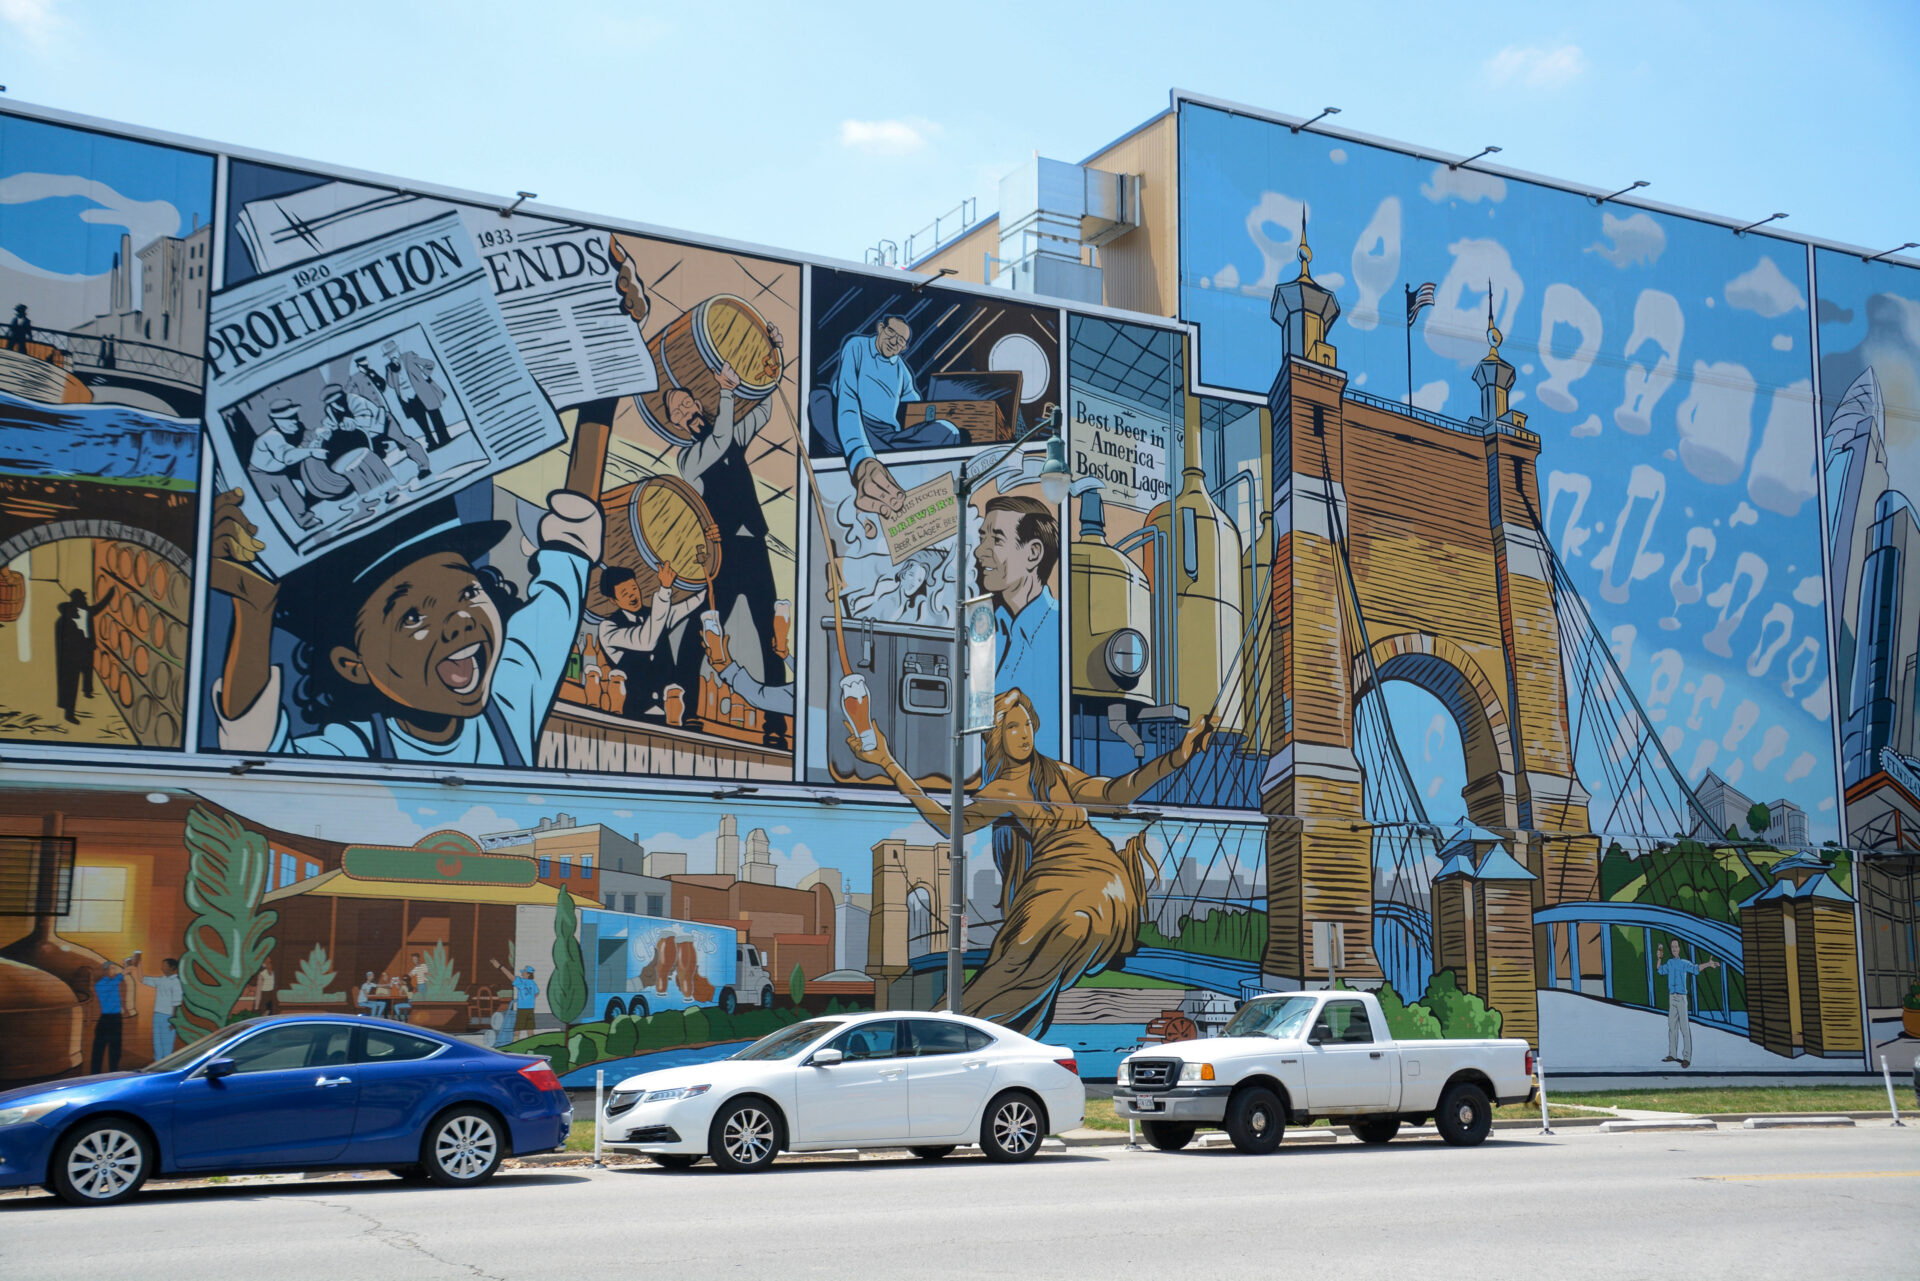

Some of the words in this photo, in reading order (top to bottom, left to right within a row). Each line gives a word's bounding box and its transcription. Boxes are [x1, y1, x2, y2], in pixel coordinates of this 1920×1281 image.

[477, 229, 513, 248] 1933
[291, 264, 330, 288] 1920
[483, 236, 609, 296] ENDS
[207, 236, 463, 381] PROHIBITION
[1076, 400, 1110, 432] Best
[1114, 415, 1147, 443] Beer
[1150, 429, 1165, 449] in
[1090, 430, 1155, 469] America
[1076, 451, 1128, 487] Boston
[1131, 467, 1171, 500] Lager
[888, 496, 955, 537] BREWERY
[943, 515, 958, 528] BEE
[1886, 755, 1920, 798] FINDLA
